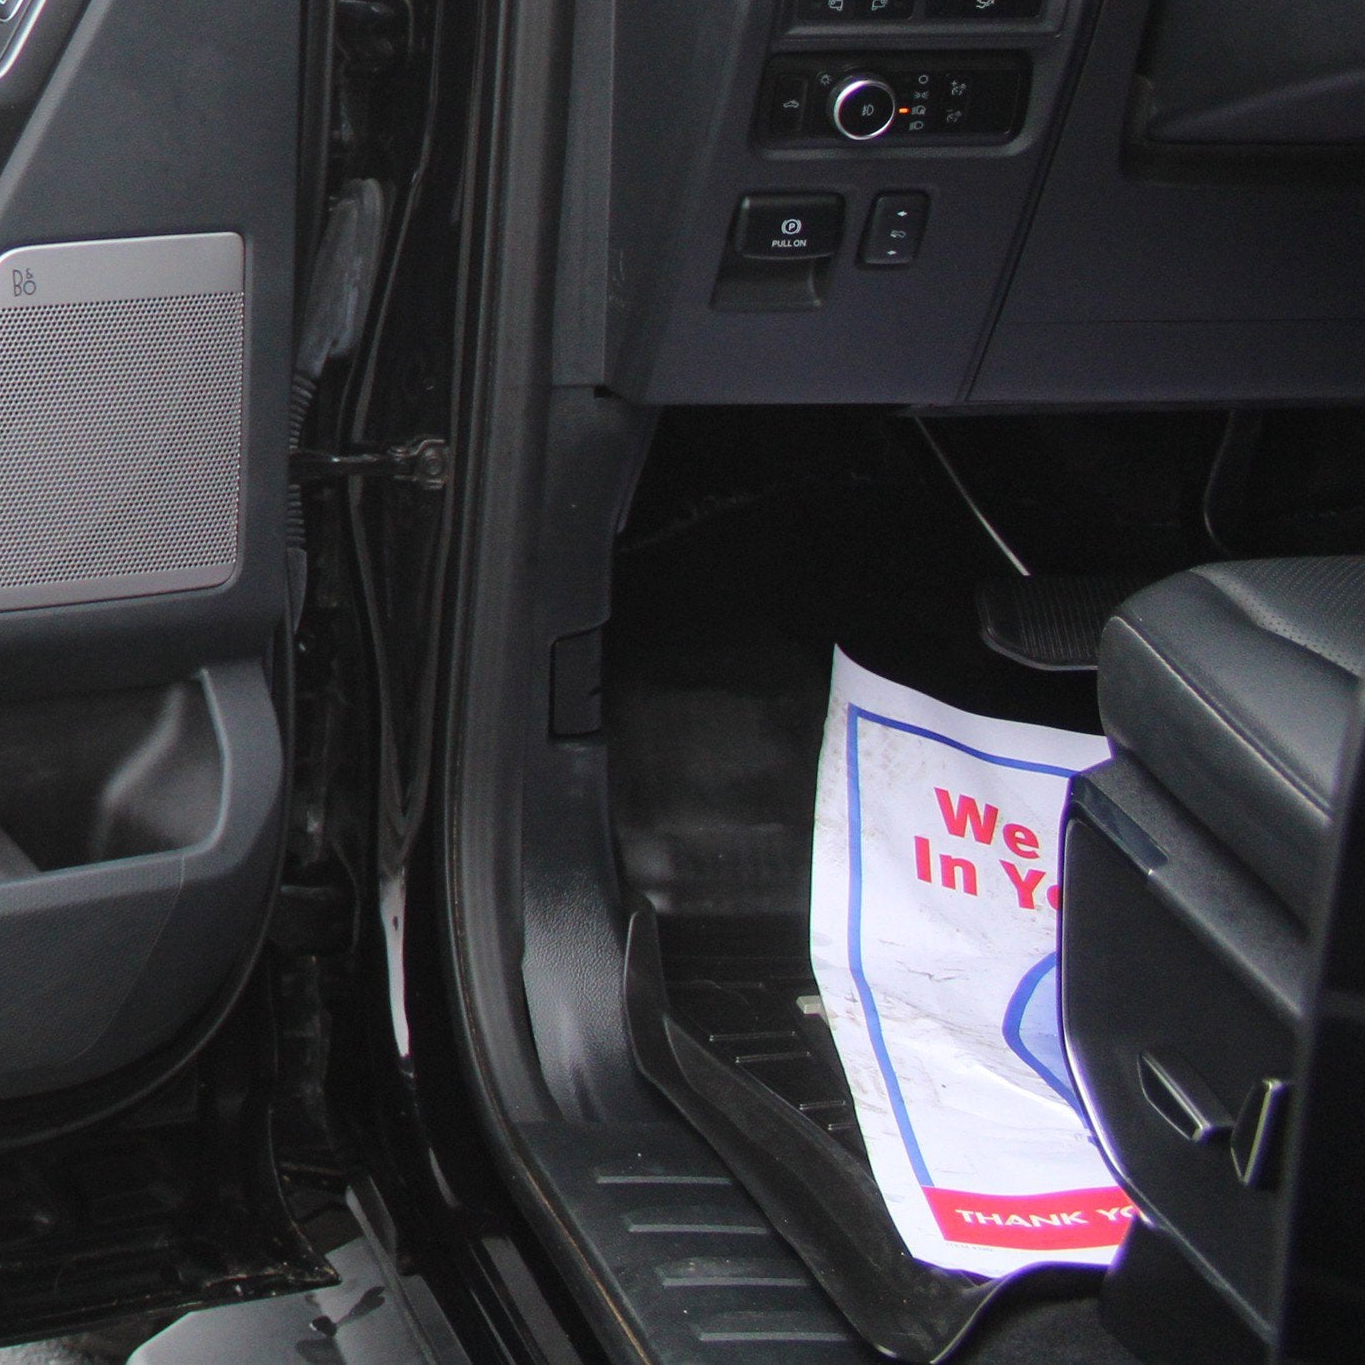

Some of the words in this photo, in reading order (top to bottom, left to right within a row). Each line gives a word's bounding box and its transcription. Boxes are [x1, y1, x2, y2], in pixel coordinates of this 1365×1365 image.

[772, 239, 792, 247] PULL
[793, 239, 807, 247] ON
[933, 786, 1040, 860] We
[914, 835, 978, 897] In
[954, 1208, 1089, 1228] THANK
